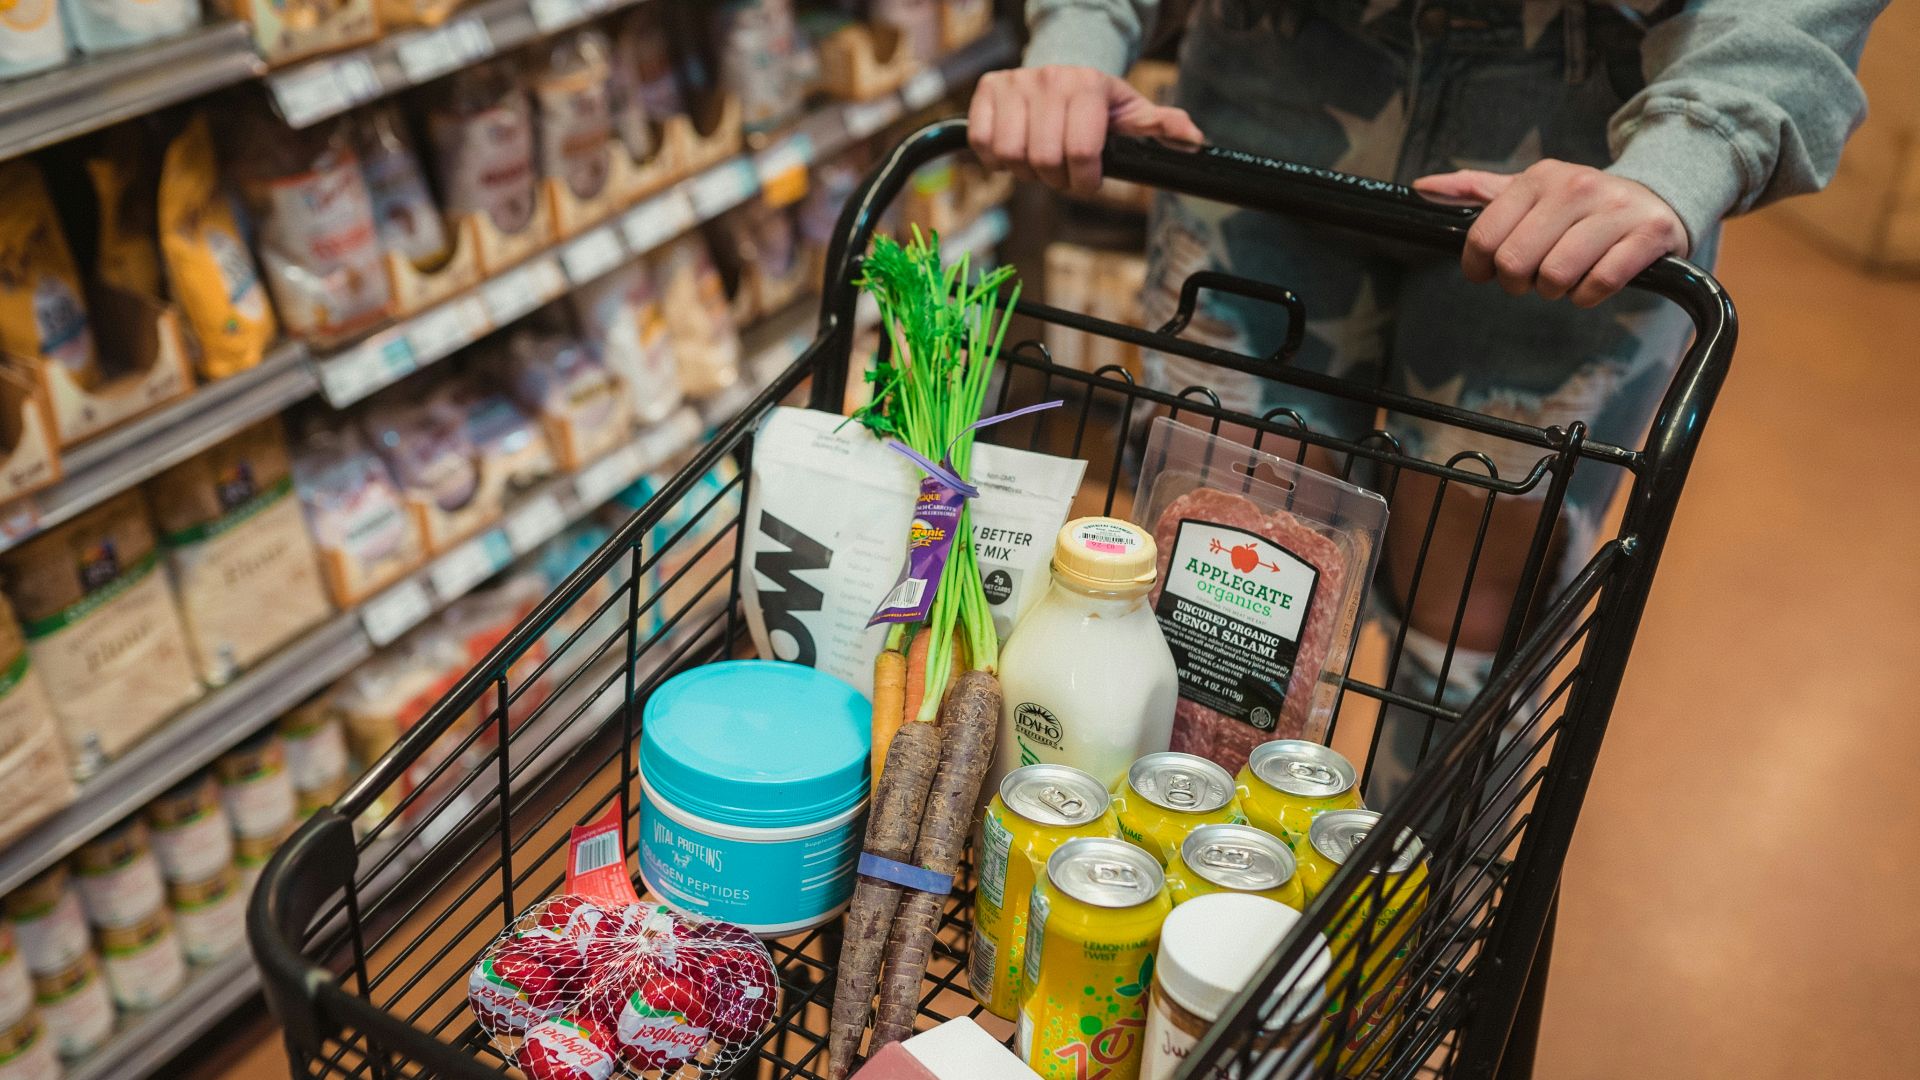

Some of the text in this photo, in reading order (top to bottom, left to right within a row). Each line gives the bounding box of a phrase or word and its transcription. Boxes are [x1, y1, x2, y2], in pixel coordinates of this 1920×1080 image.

[911, 527, 945, 538] rganic
[980, 526, 1033, 547] BETTER
[984, 544, 1011, 561] MIX
[993, 575, 1004, 586] 2g
[994, 585, 1011, 595] CARBS
[1185, 557, 1293, 610] APPLEGATE
[1172, 610, 1278, 659] GENOA SALAMI
[1177, 600, 1280, 647] UNCURED ORGANIC
[1171, 637, 1202, 655] ANTIBIOTICS
[1222, 659, 1252, 675] HUMANELY
[1187, 651, 1208, 665] GLUTEN
[1230, 668, 1244, 679] FREE
[1188, 629, 1207, 641] nitrates
[1208, 638, 1224, 648] added
[1224, 644, 1241, 655] except
[1242, 650, 1250, 658] for
[1251, 653, 1266, 664] those
[1265, 660, 1290, 674] naturally
[1194, 638, 1204, 646] salt
[1203, 642, 1215, 650] and
[1213, 645, 1236, 659] cultured
[1235, 655, 1252, 667] celery
[1251, 661, 1265, 671] juice
[1178, 667, 1244, 702] NET WT. 4 OZ. (113g)
[1188, 662, 1238, 687] KEEP REFRIGERATED
[1018, 713, 1060, 739] IDAHO
[653, 818, 723, 873] VITAL PROTEINS
[1124, 826, 1143, 843] LIME
[642, 839, 684, 884] COLLAGEN
[687, 877, 751, 901] PEPTIDES
[1083, 938, 1149, 952] LEMON LIME
[1083, 951, 1117, 962] TWIST
[531, 1026, 604, 1068] Babybel
[631, 1024, 708, 1054] Babybel
